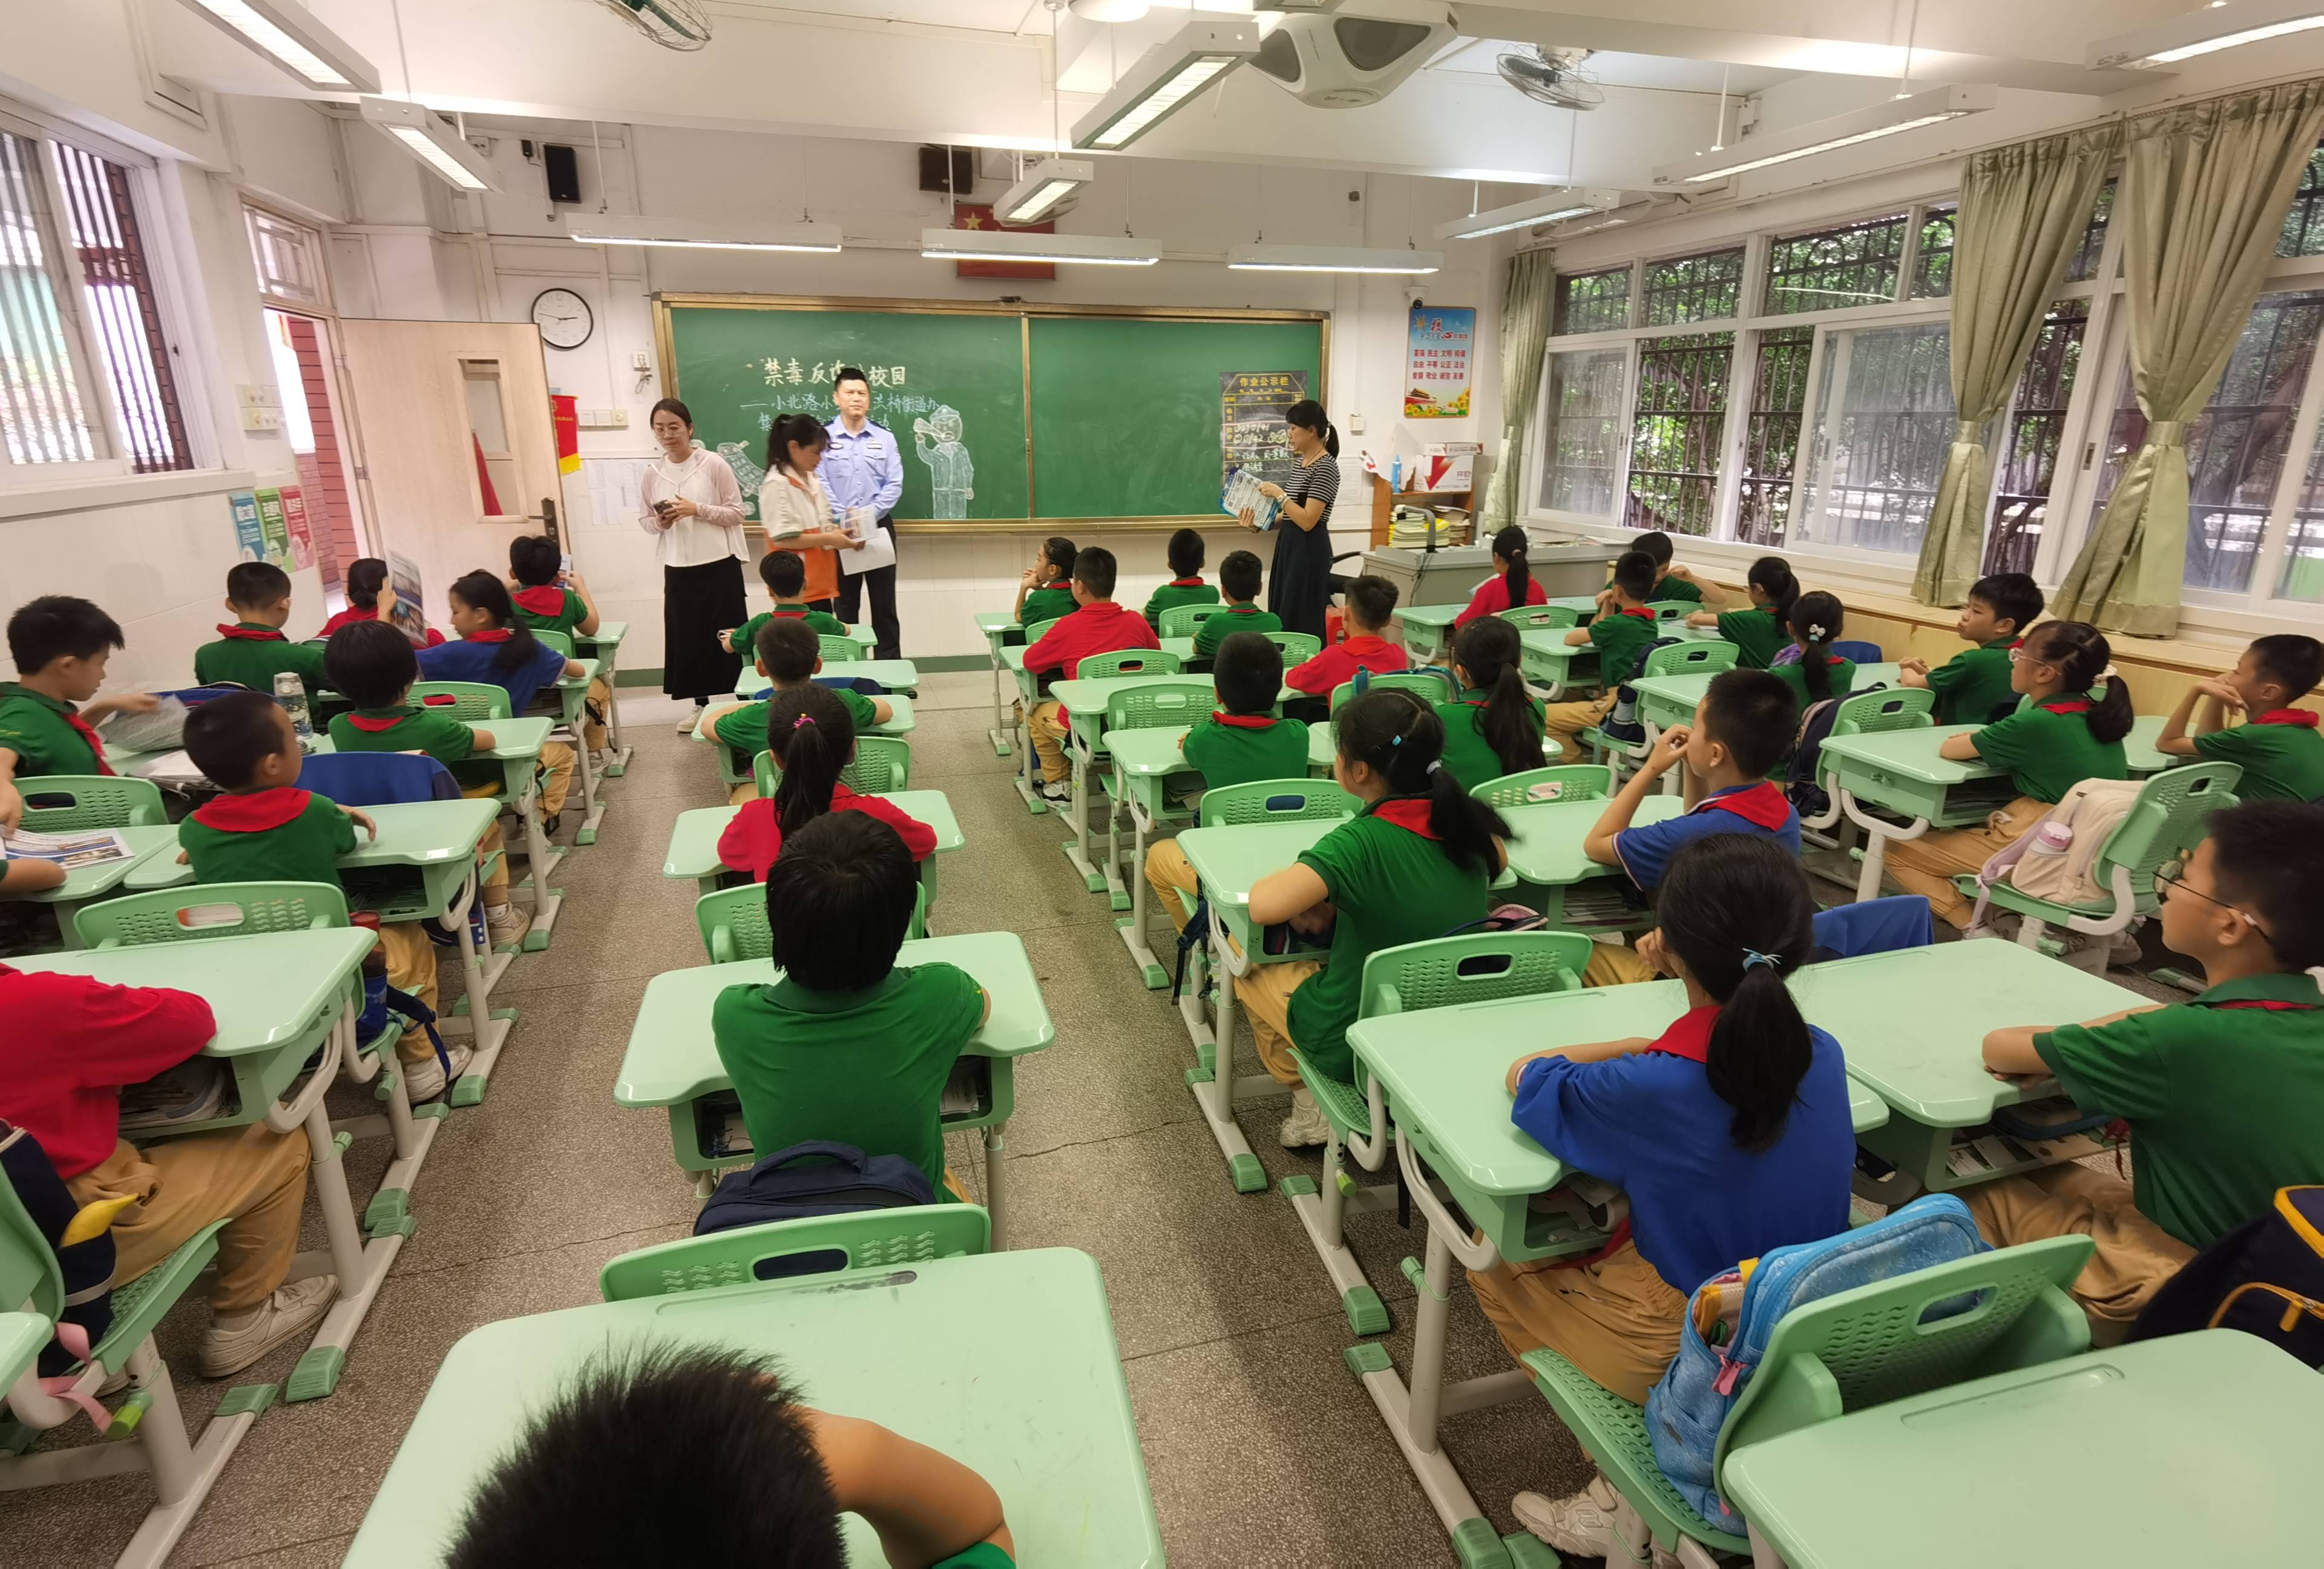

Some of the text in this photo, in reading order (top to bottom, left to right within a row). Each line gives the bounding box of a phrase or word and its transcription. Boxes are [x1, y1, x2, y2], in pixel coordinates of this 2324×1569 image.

[1239, 377, 1289, 387] 作业公示栏
